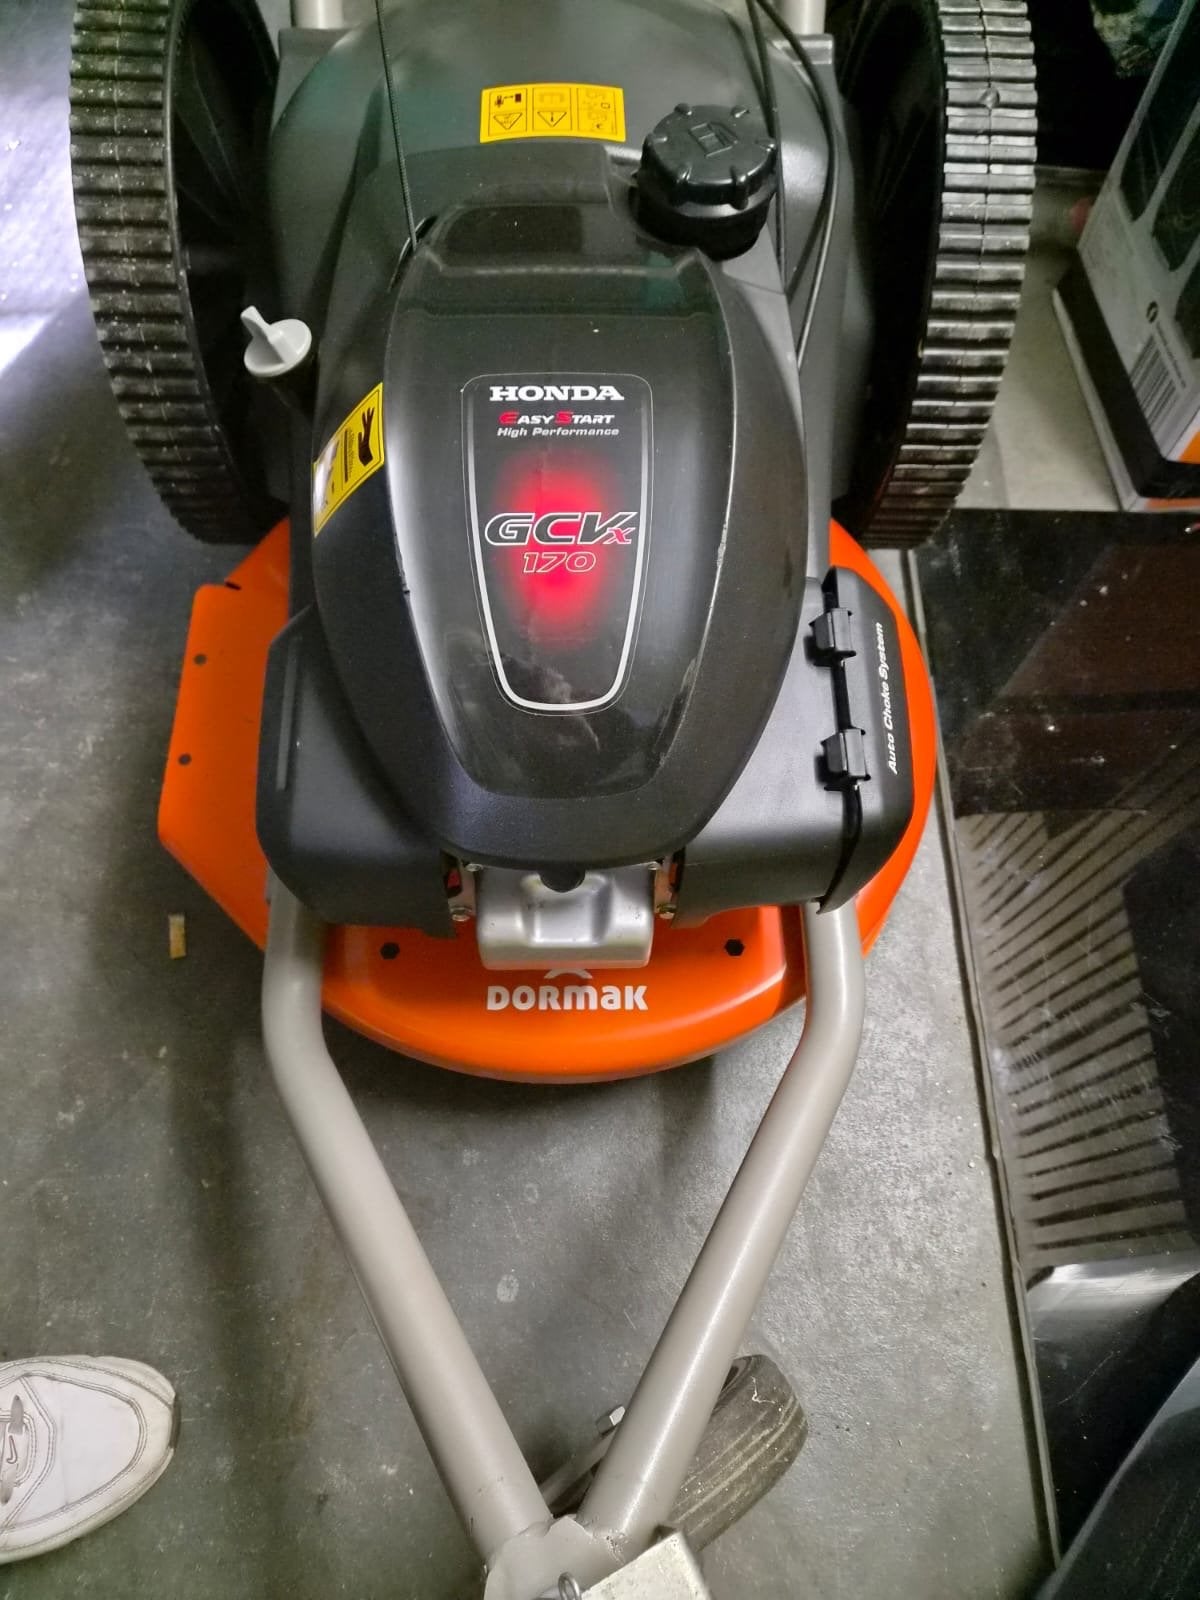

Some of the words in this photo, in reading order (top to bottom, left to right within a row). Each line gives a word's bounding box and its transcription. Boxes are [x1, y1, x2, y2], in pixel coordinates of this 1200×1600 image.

[489, 385, 625, 401] HONDA
[499, 411, 554, 425] EASY
[554, 411, 615, 425] START
[496, 427, 527, 438] High
[532, 427, 620, 436] Performance
[523, 551, 597, 573] 170
[875, 622, 890, 680] System
[880, 681, 893, 729] Choke
[887, 732, 898, 775] Auto
